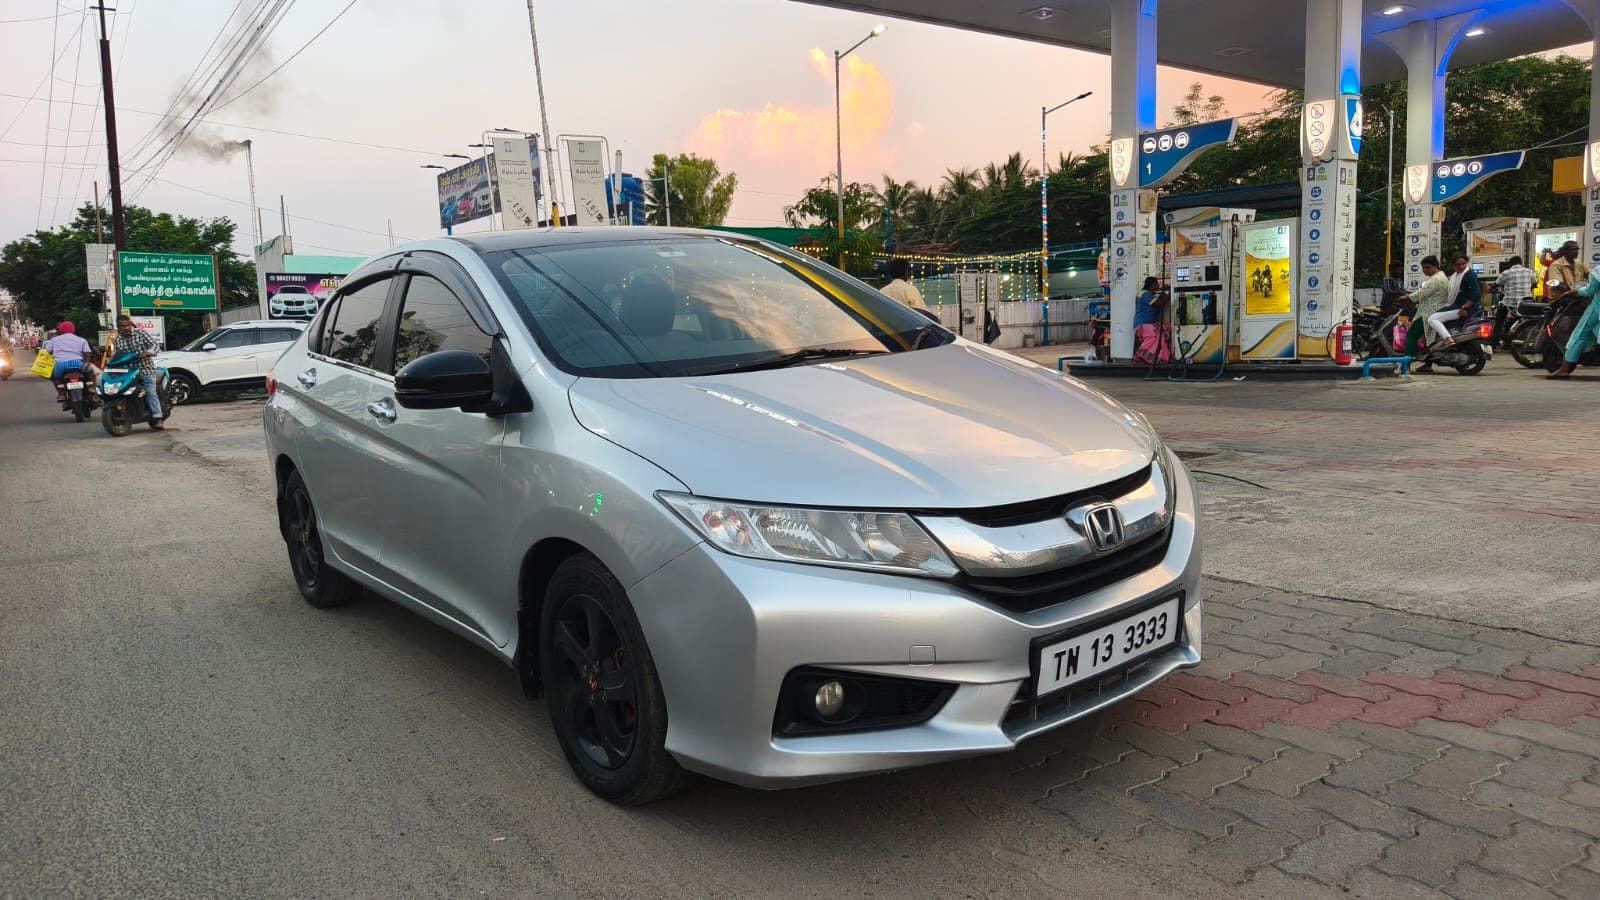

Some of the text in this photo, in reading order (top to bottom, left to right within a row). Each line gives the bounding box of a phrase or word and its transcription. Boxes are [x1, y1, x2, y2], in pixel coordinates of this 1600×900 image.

[1145, 162, 1152, 176] 1
[1439, 184, 1447, 195] 3
[124, 284, 215, 296] அறிவுத்திருக்கோயில்
[1054, 612, 1168, 681] TN 13 3333
